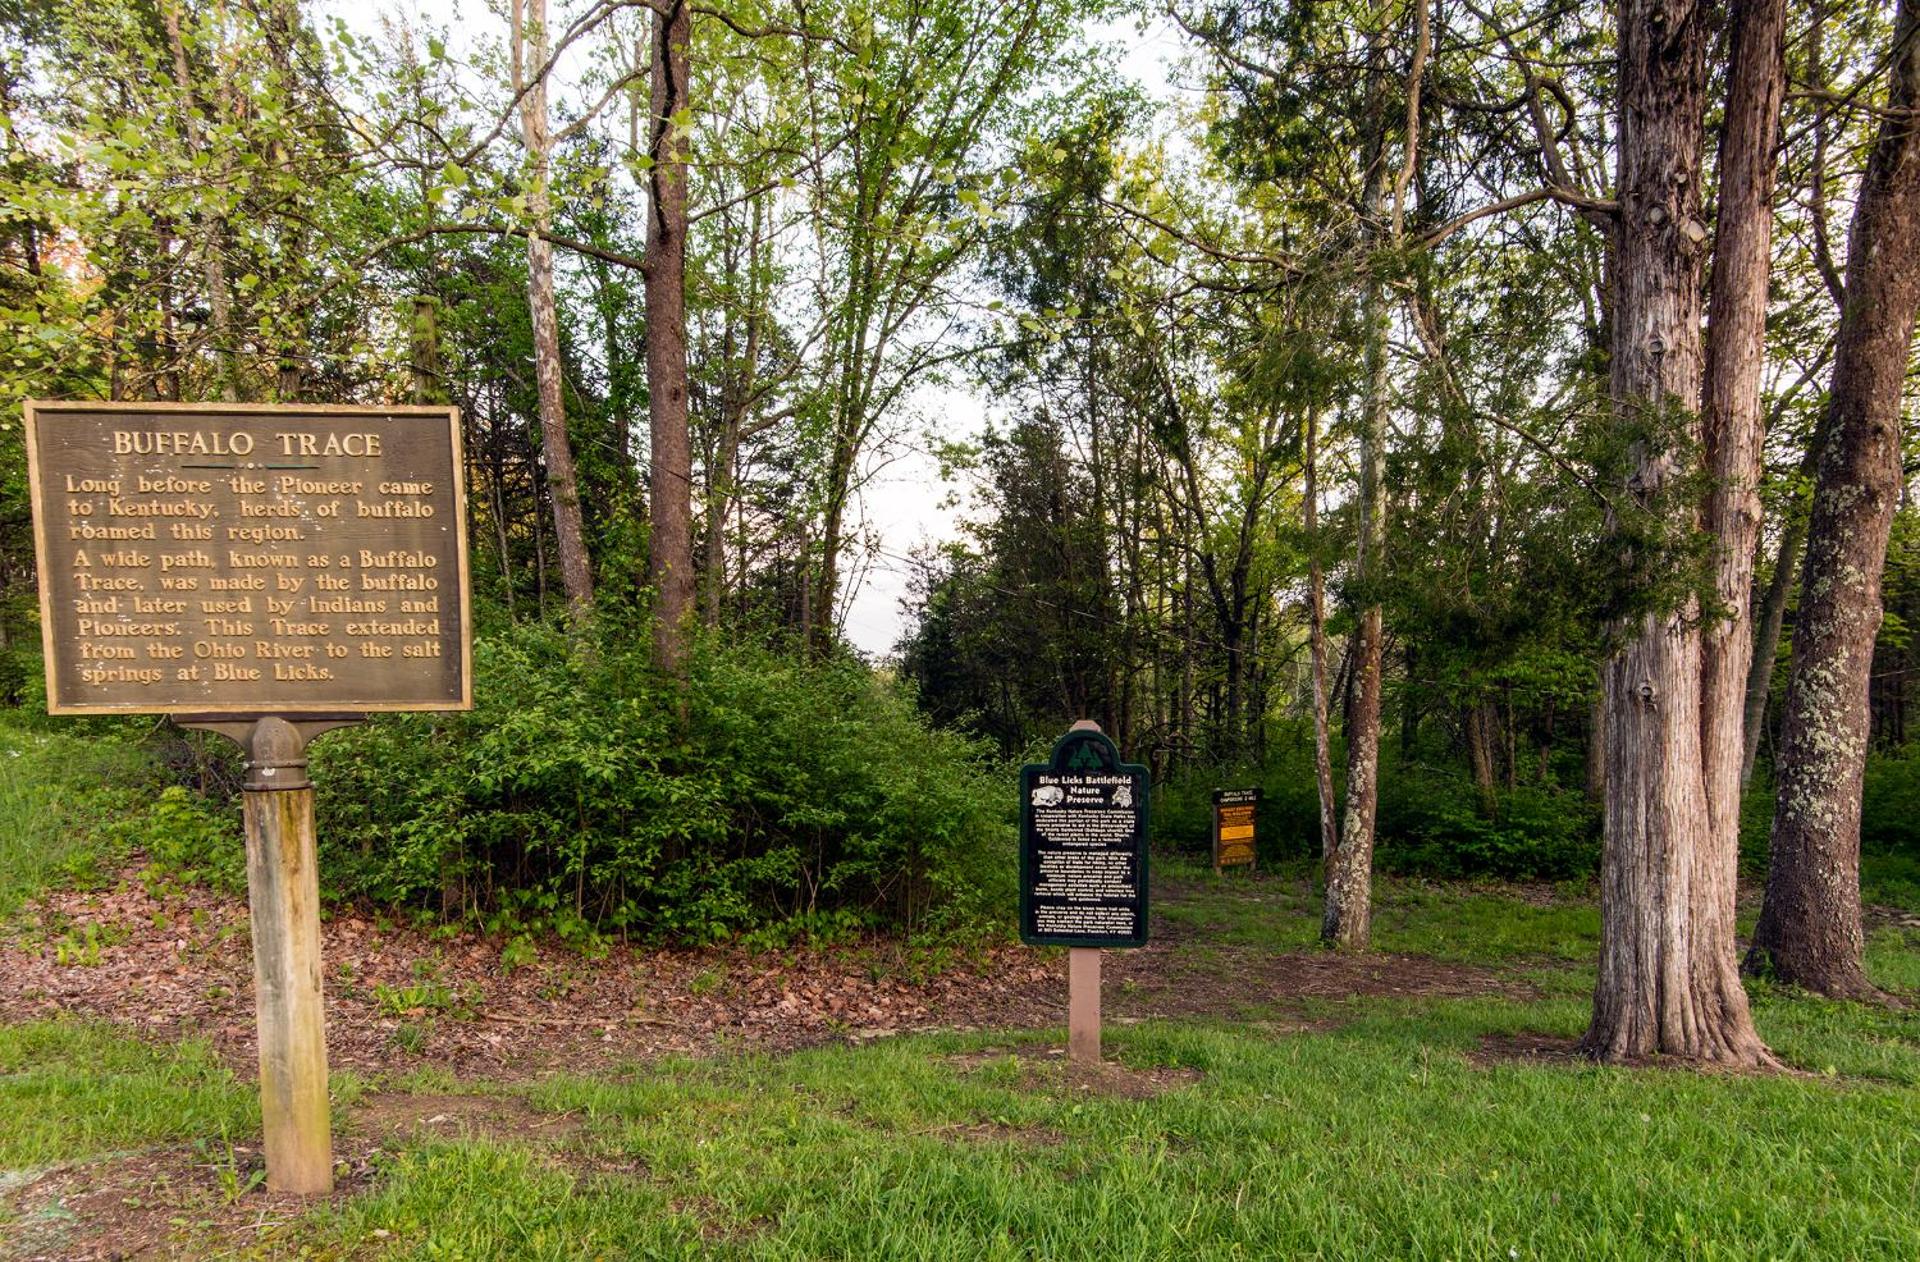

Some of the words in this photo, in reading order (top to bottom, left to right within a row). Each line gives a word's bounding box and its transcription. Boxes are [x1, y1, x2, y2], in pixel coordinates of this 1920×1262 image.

[113, 431, 254, 456] BUFFALO
[275, 432, 382, 457] TRACE
[65, 475, 120, 497] Long
[137, 476, 211, 494] before
[229, 477, 266, 494] the
[281, 476, 362, 495] Pioneer
[378, 481, 434, 496] came
[68, 499, 93, 516] to
[240, 500, 301, 517] herds
[316, 501, 341, 518] of
[356, 501, 434, 519] buffalo
[71, 523, 156, 540] roamed
[169, 524, 213, 540] this
[227, 525, 305, 544] region.
[73, 549, 92, 567] A
[101, 551, 151, 568] wide
[229, 551, 299, 568] known
[307, 554, 330, 568] as
[339, 555, 351, 568] a
[359, 550, 437, 568] Buffalo
[160, 577, 198, 591] was
[210, 575, 265, 591] made
[276, 573, 304, 592] by
[315, 575, 350, 590] the
[361, 574, 438, 591] buffalo
[75, 597, 118, 614] and
[134, 597, 187, 613] later
[200, 597, 252, 613] used
[267, 597, 294, 615] by
[309, 597, 387, 613] Indians
[400, 596, 439, 613] and
[204, 619, 253, 636] This
[270, 618, 330, 636] Trace
[345, 619, 440, 636] extended
[80, 642, 136, 660] from
[146, 642, 183, 659] the
[194, 641, 246, 659] Ohio
[255, 641, 314, 658] River
[326, 642, 349, 659] to
[360, 642, 393, 658] the
[402, 641, 441, 658] salt
[81, 666, 162, 685] springs
[177, 665, 200, 681] at
[213, 663, 261, 681] Blue
[274, 663, 334, 681] Licks.
[1039, 776, 1059, 784] Blue
[1061, 776, 1083, 784] Licks
[1085, 776, 1132, 785] Battlefield
[1070, 786, 1101, 794] Nature
[1066, 795, 1104, 804] Preserve
